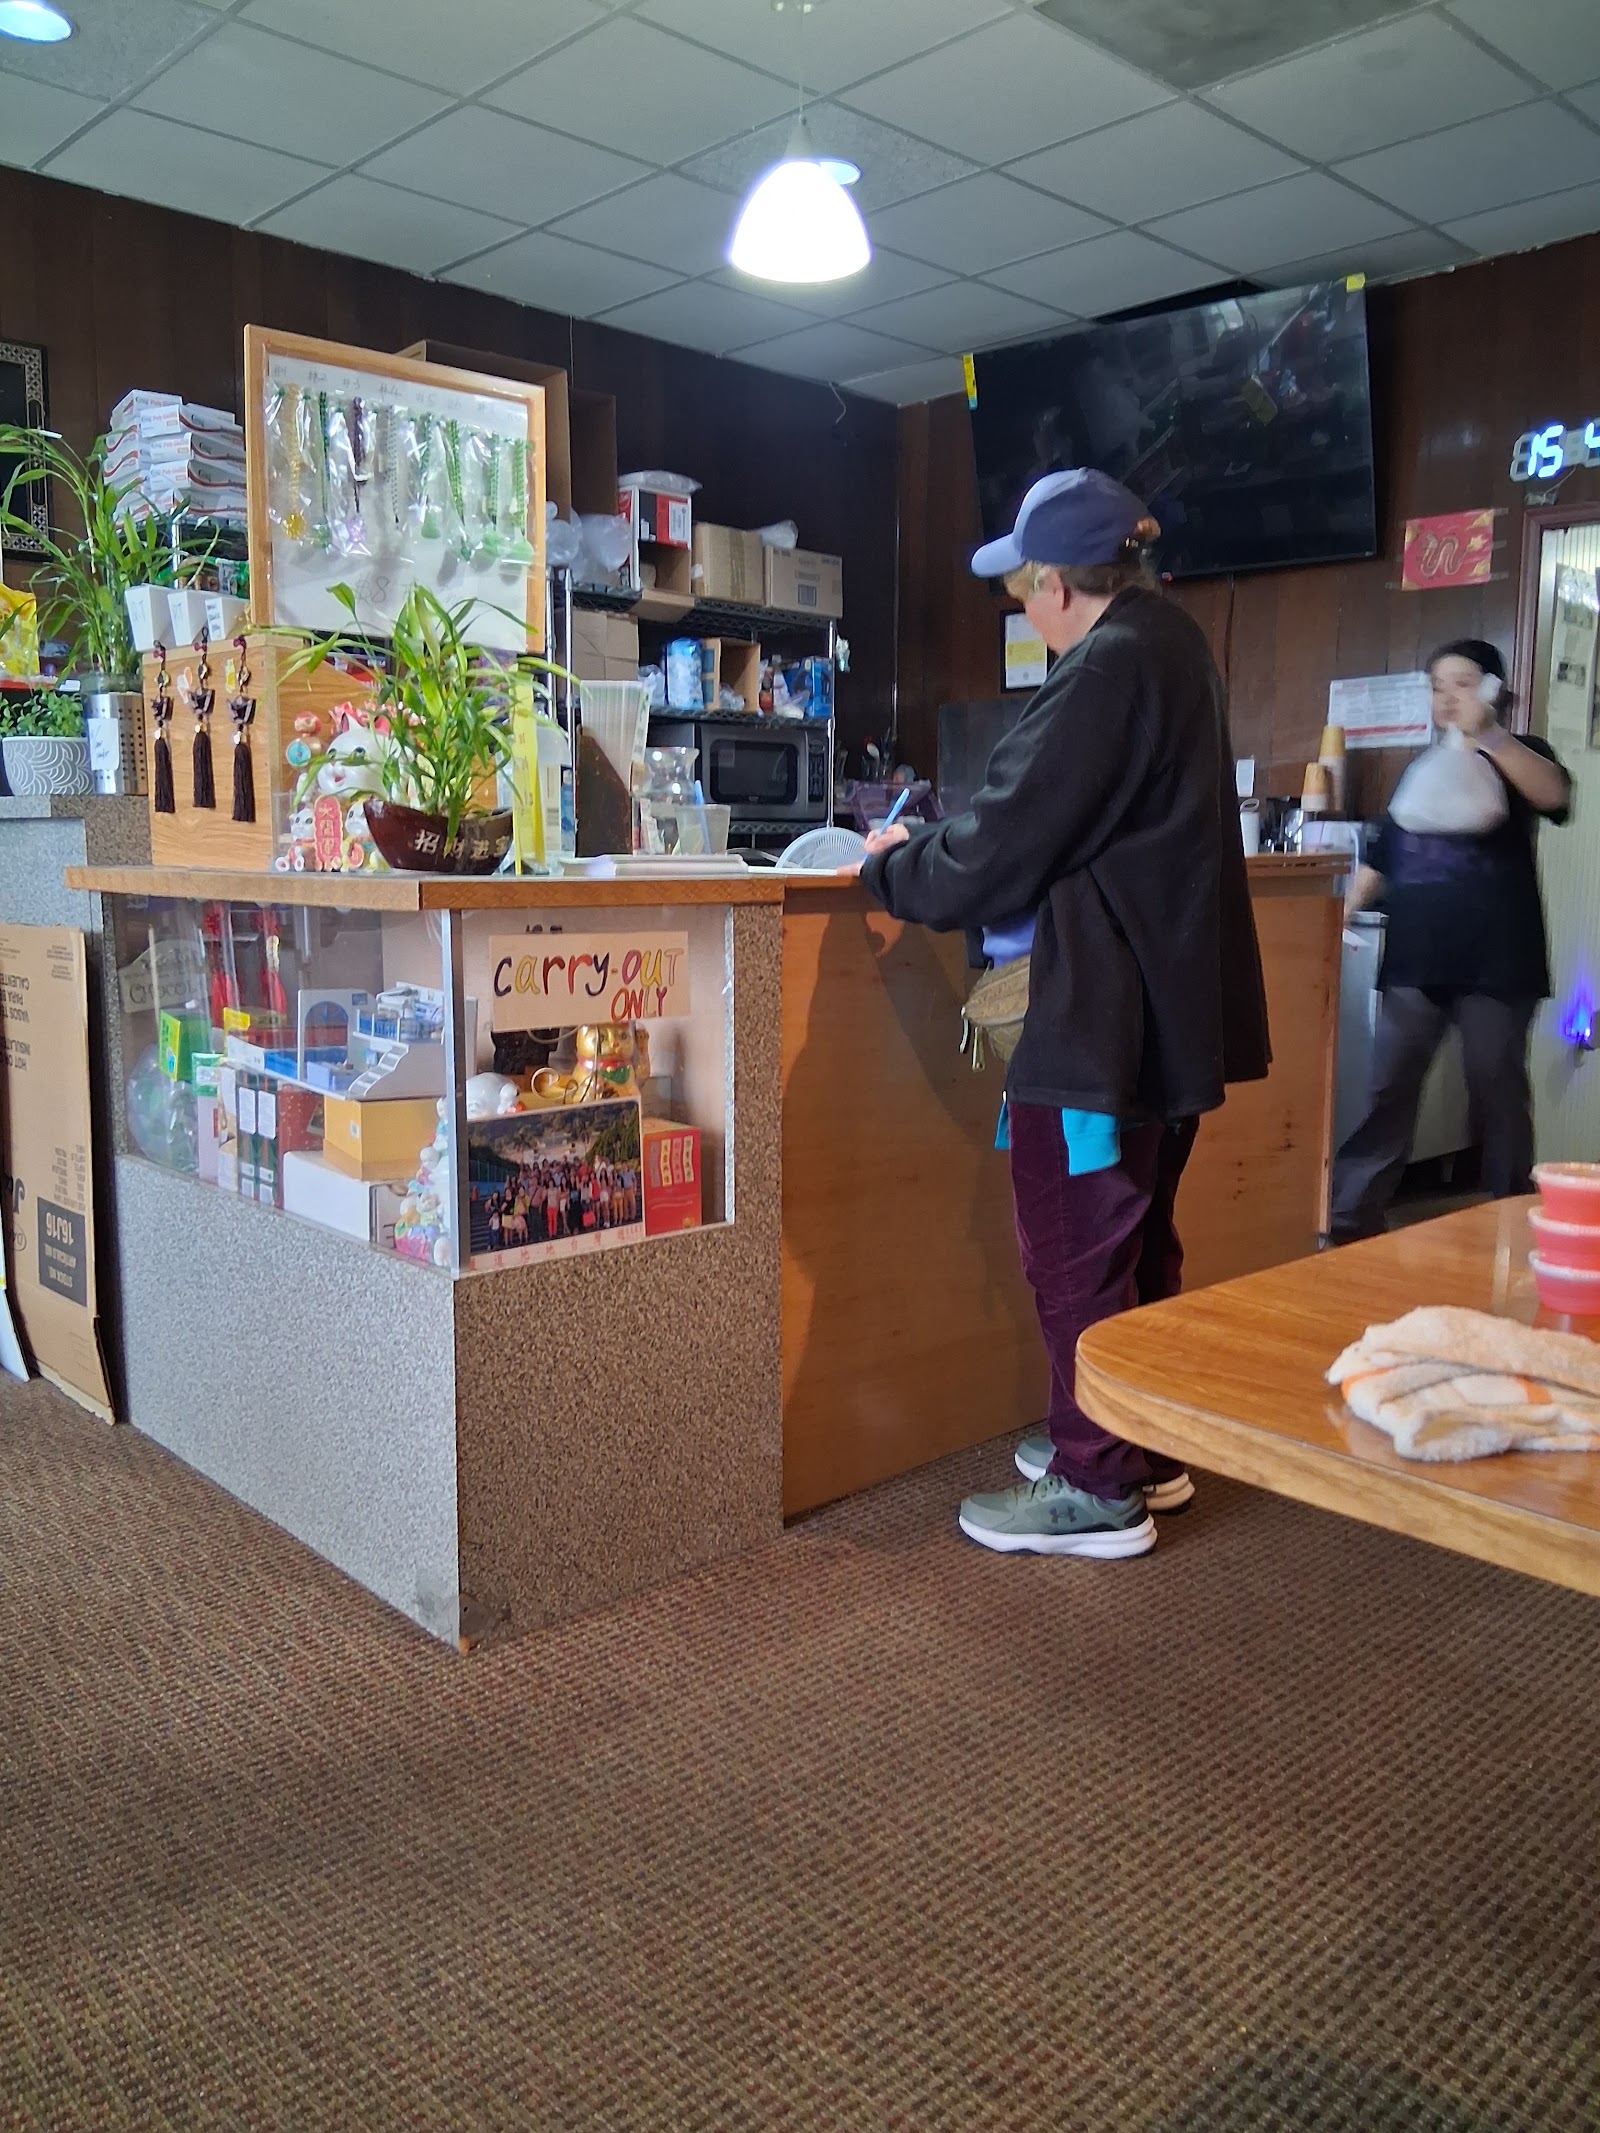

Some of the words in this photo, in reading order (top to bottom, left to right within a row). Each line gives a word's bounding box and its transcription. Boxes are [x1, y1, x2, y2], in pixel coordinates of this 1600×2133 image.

[610, 986, 668, 1022] ONLY
[15, 1057, 28, 1072] HOT
[46, 1212, 74, 1246] 16J16
